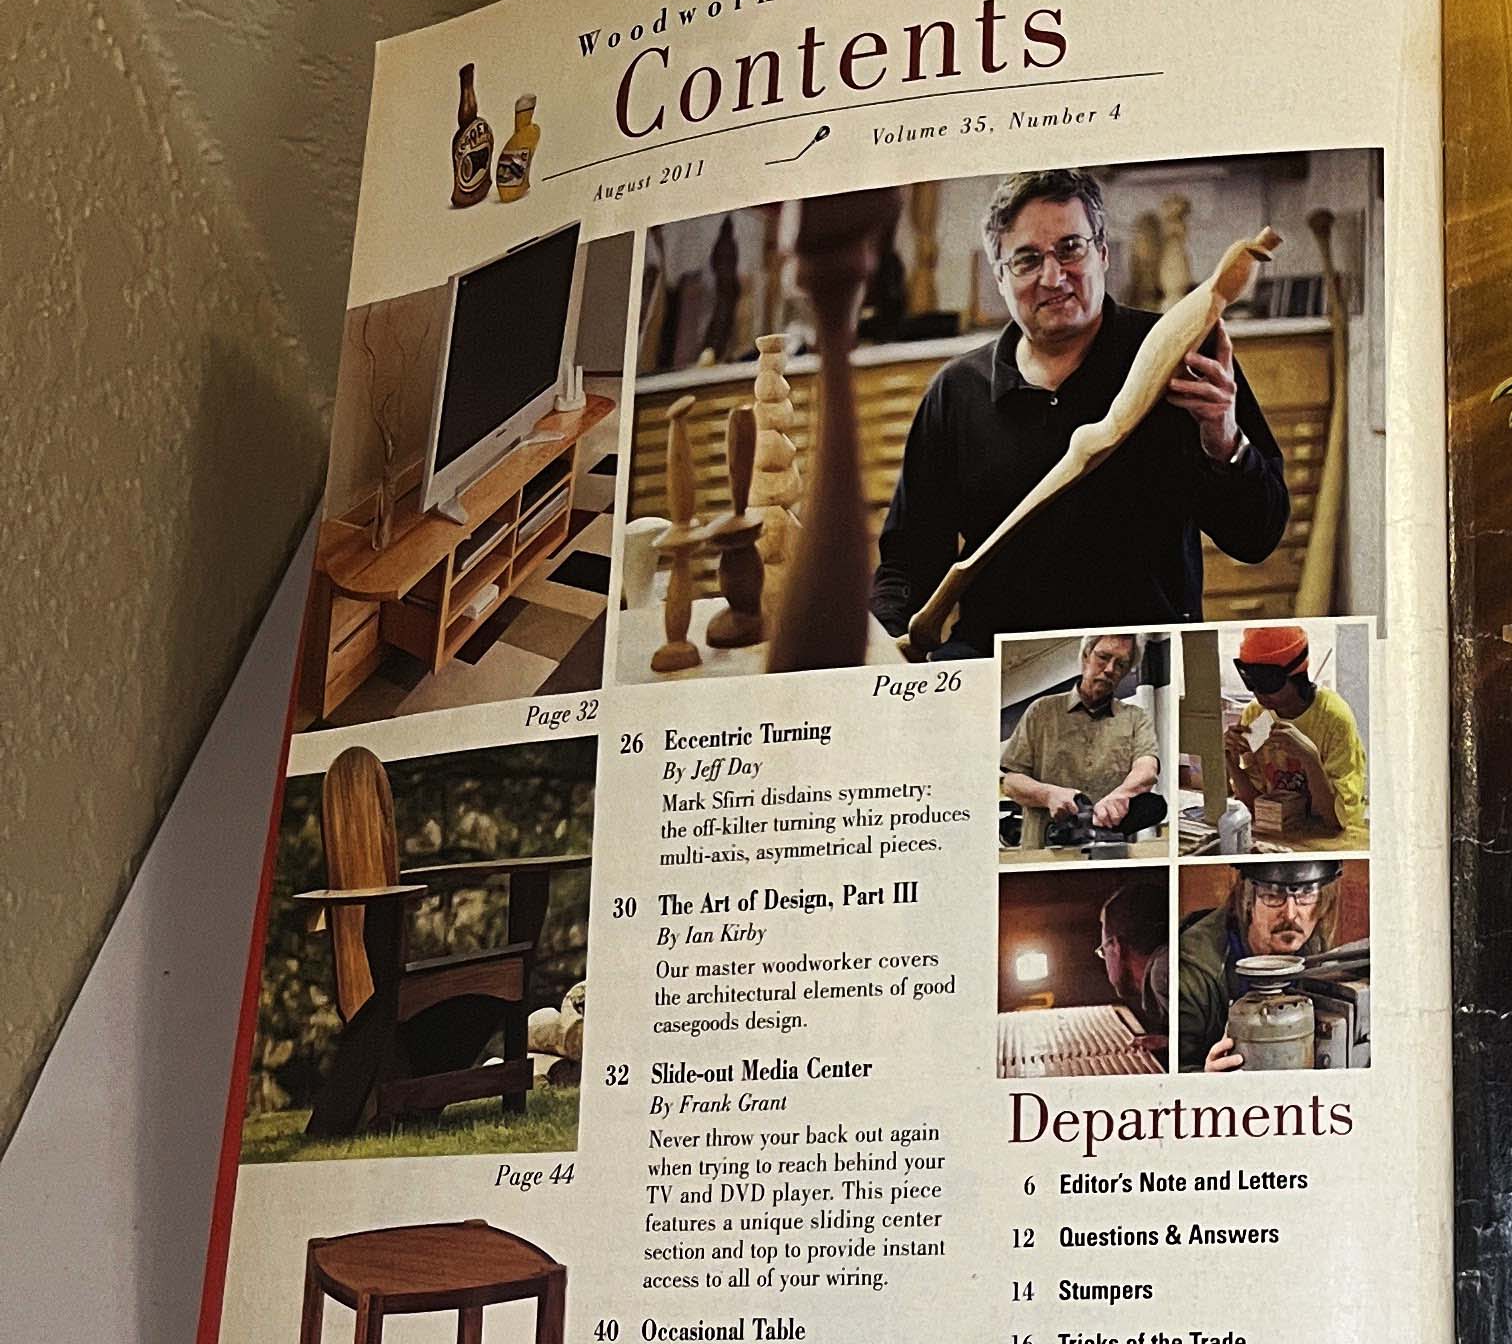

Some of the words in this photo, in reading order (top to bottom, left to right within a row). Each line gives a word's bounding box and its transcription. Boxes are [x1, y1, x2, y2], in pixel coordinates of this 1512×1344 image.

[592, 175, 651, 202] August
[659, 159, 704, 185] 2011
[873, 124, 948, 146] Volume
[959, 115, 994, 134] 35,
[1008, 106, 1098, 130] Number
[1108, 103, 1121, 121] 4
[872, 675, 928, 702] Page
[934, 669, 962, 693] 26
[525, 705, 571, 731] Page
[575, 698, 599, 722] 32
[620, 732, 644, 755] 26
[664, 726, 753, 751] Eccentric
[759, 720, 832, 746] Turning
[662, 761, 687, 785] By
[690, 757, 726, 783] Jeff
[727, 757, 763, 779] Day
[612, 896, 637, 919] 30
[658, 893, 694, 916] The
[699, 892, 730, 914] Art
[737, 889, 759, 912] of
[764, 888, 834, 915] Design,
[842, 884, 884, 906] Part
[893, 881, 918, 904] III
[656, 926, 677, 951] By
[684, 925, 714, 945] Ian
[720, 921, 767, 946] Kirby
[605, 1064, 629, 1087] 32
[651, 1061, 734, 1085] Slide-out
[741, 1057, 799, 1082] Media
[806, 1056, 873, 1079] Center
[649, 1095, 670, 1120] By
[678, 1093, 732, 1114] Frank
[738, 1092, 787, 1112] Grant
[1007, 1092, 1353, 1158] Departments
[494, 1164, 543, 1192] Page
[548, 1162, 575, 1185] 44
[1023, 1175, 1036, 1196] 6
[1060, 1172, 1133, 1195] Editor's
[1139, 1171, 1187, 1193] Note
[1194, 1170, 1231, 1191] and
[1238, 1169, 1308, 1190] Letters
[1012, 1228, 1035, 1249] 12
[1059, 1225, 1159, 1248] Questions
[1165, 1224, 1182, 1246] &
[1188, 1223, 1279, 1245] Answers
[1012, 1280, 1035, 1302] 14
[1058, 1279, 1153, 1306] Stumpers
[593, 1319, 619, 1342] 40
[641, 1317, 745, 1342] Occasional
[752, 1317, 806, 1341] Table
